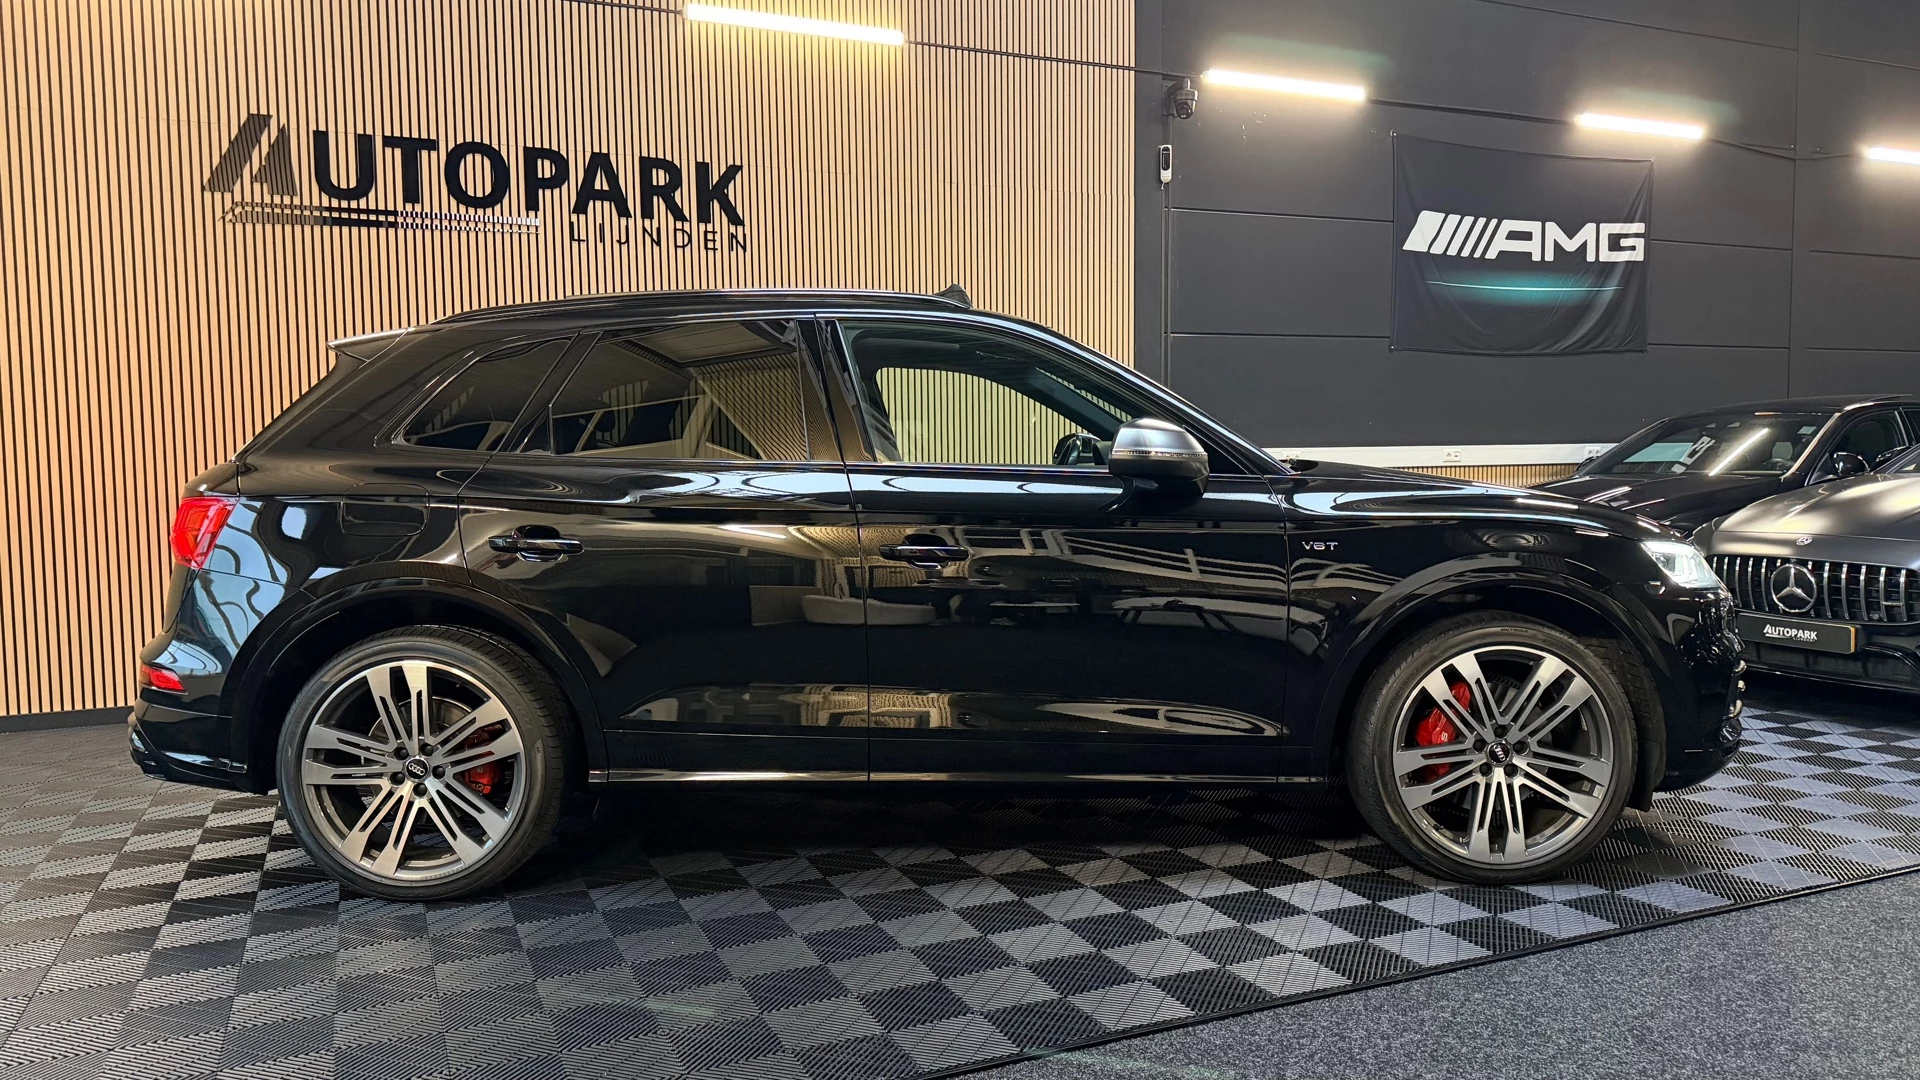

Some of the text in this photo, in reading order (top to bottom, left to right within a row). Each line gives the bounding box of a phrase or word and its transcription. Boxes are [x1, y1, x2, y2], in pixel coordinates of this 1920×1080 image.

[203, 112, 745, 227] AUTOPARK
[570, 220, 747, 253] LIJNDEN
[1484, 219, 1646, 263] AMG
[1301, 541, 1338, 551] V6T
[1763, 624, 1818, 641] AUTOPARK
